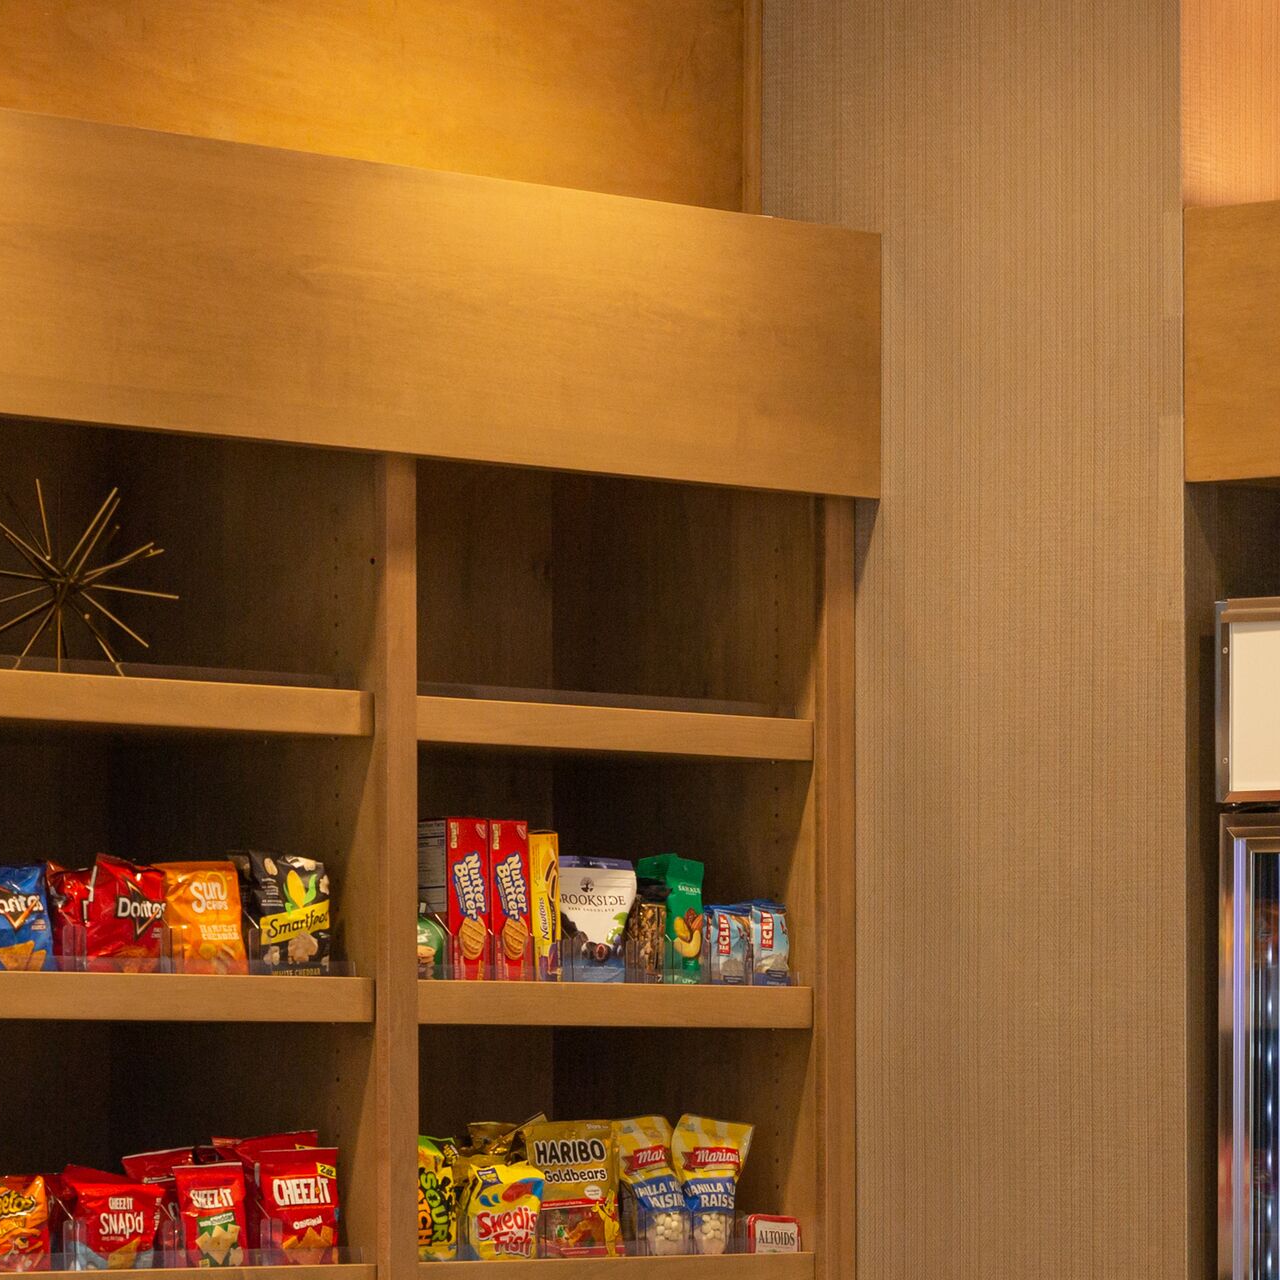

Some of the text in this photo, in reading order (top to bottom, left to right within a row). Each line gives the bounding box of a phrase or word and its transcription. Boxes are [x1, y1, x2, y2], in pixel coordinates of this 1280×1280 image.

[190, 877, 227, 913] Sun
[455, 862, 478, 921] Butter
[465, 852, 486, 913] Nutter
[496, 863, 519, 921] Butter
[507, 853, 527, 913] Nutter
[540, 897, 550, 940] Newtons
[560, 894, 626, 908] ROOKSIDE
[534, 1139, 606, 1165] HARIBO
[544, 1168, 607, 1184] Goldbears
[421, 1171, 448, 1241] SOUR
[477, 1207, 537, 1239] Swedis
[492, 1230, 533, 1257] Fish
[757, 1229, 795, 1246] ALTOIDS
